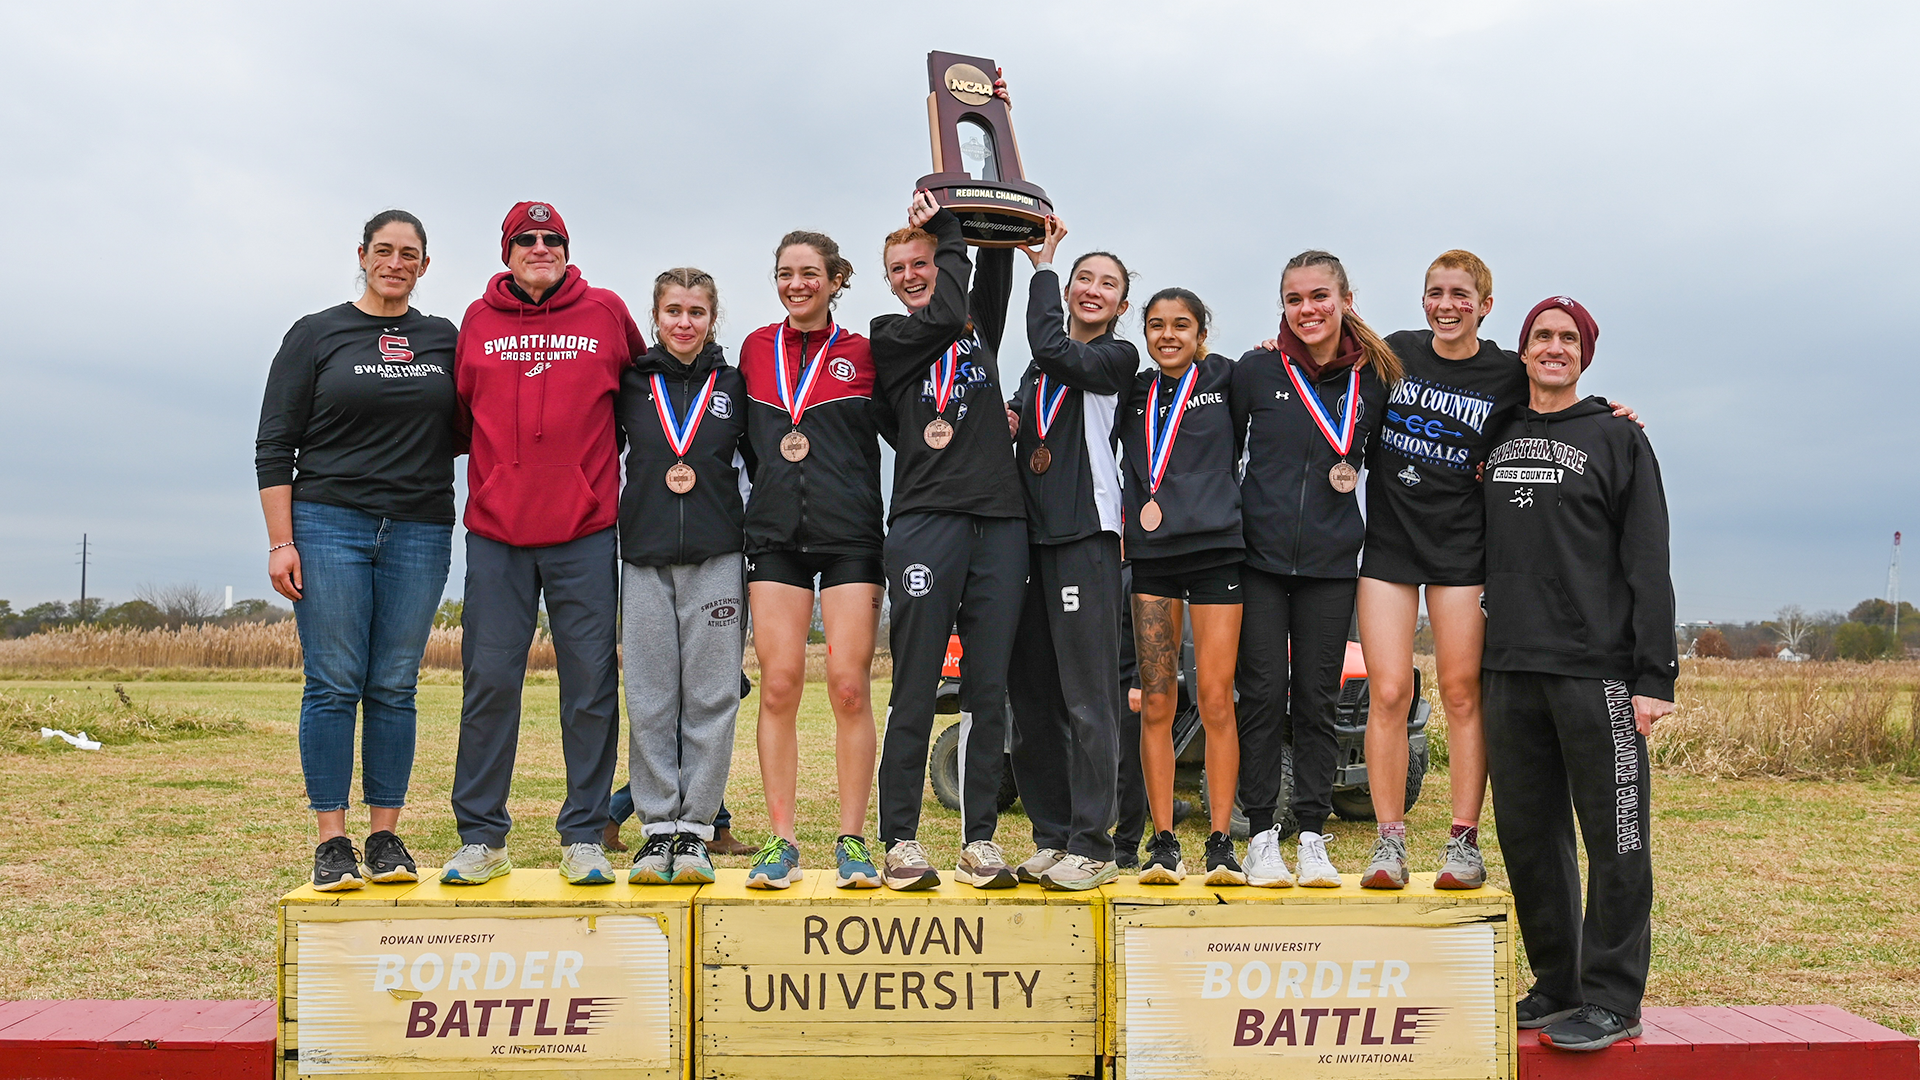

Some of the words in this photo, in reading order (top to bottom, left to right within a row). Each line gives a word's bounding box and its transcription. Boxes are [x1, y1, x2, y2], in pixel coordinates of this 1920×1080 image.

[951, 79, 993, 96] NCAA
[956, 188, 994, 199] REGIONAL
[995, 191, 1034, 206] CHAMPION
[962, 220, 1033, 234] CHAMPIONSHIPS
[379, 334, 414, 363] S
[483, 334, 599, 356] SWARTHMORE
[500, 351, 532, 361] CROSS
[354, 364, 445, 375] SWARTHMORE
[836, 362, 851, 377] S
[712, 396, 728, 415] S
[1420, 387, 1495, 436] COUNTRY
[1485, 438, 1588, 475] SWARTHMORE
[1495, 471, 1518, 480] CROSS
[909, 570, 926, 590] S
[1061, 585, 1080, 612] S
[708, 616, 739, 627] ATHLETICS
[718, 608, 729, 618] 82
[1616, 785, 1642, 855] COLLEGE
[380, 936, 424, 946] ROWAN
[427, 934, 495, 945] UNIVERSITY
[803, 915, 984, 956] ROWAN
[1207, 943, 1250, 953] ROWAN
[1253, 941, 1322, 952] UNIVERSITY
[373, 950, 584, 992] BORDER
[1201, 960, 1410, 999] BORDER
[744, 970, 1041, 1012] UNIVERSITY
[405, 998, 596, 1039] BATTLE
[1233, 1007, 1420, 1047] BATTLE
[490, 1045, 505, 1055] XC
[1317, 1055, 1333, 1064] XC
[1335, 1053, 1415, 1064] INVITATIONAL
